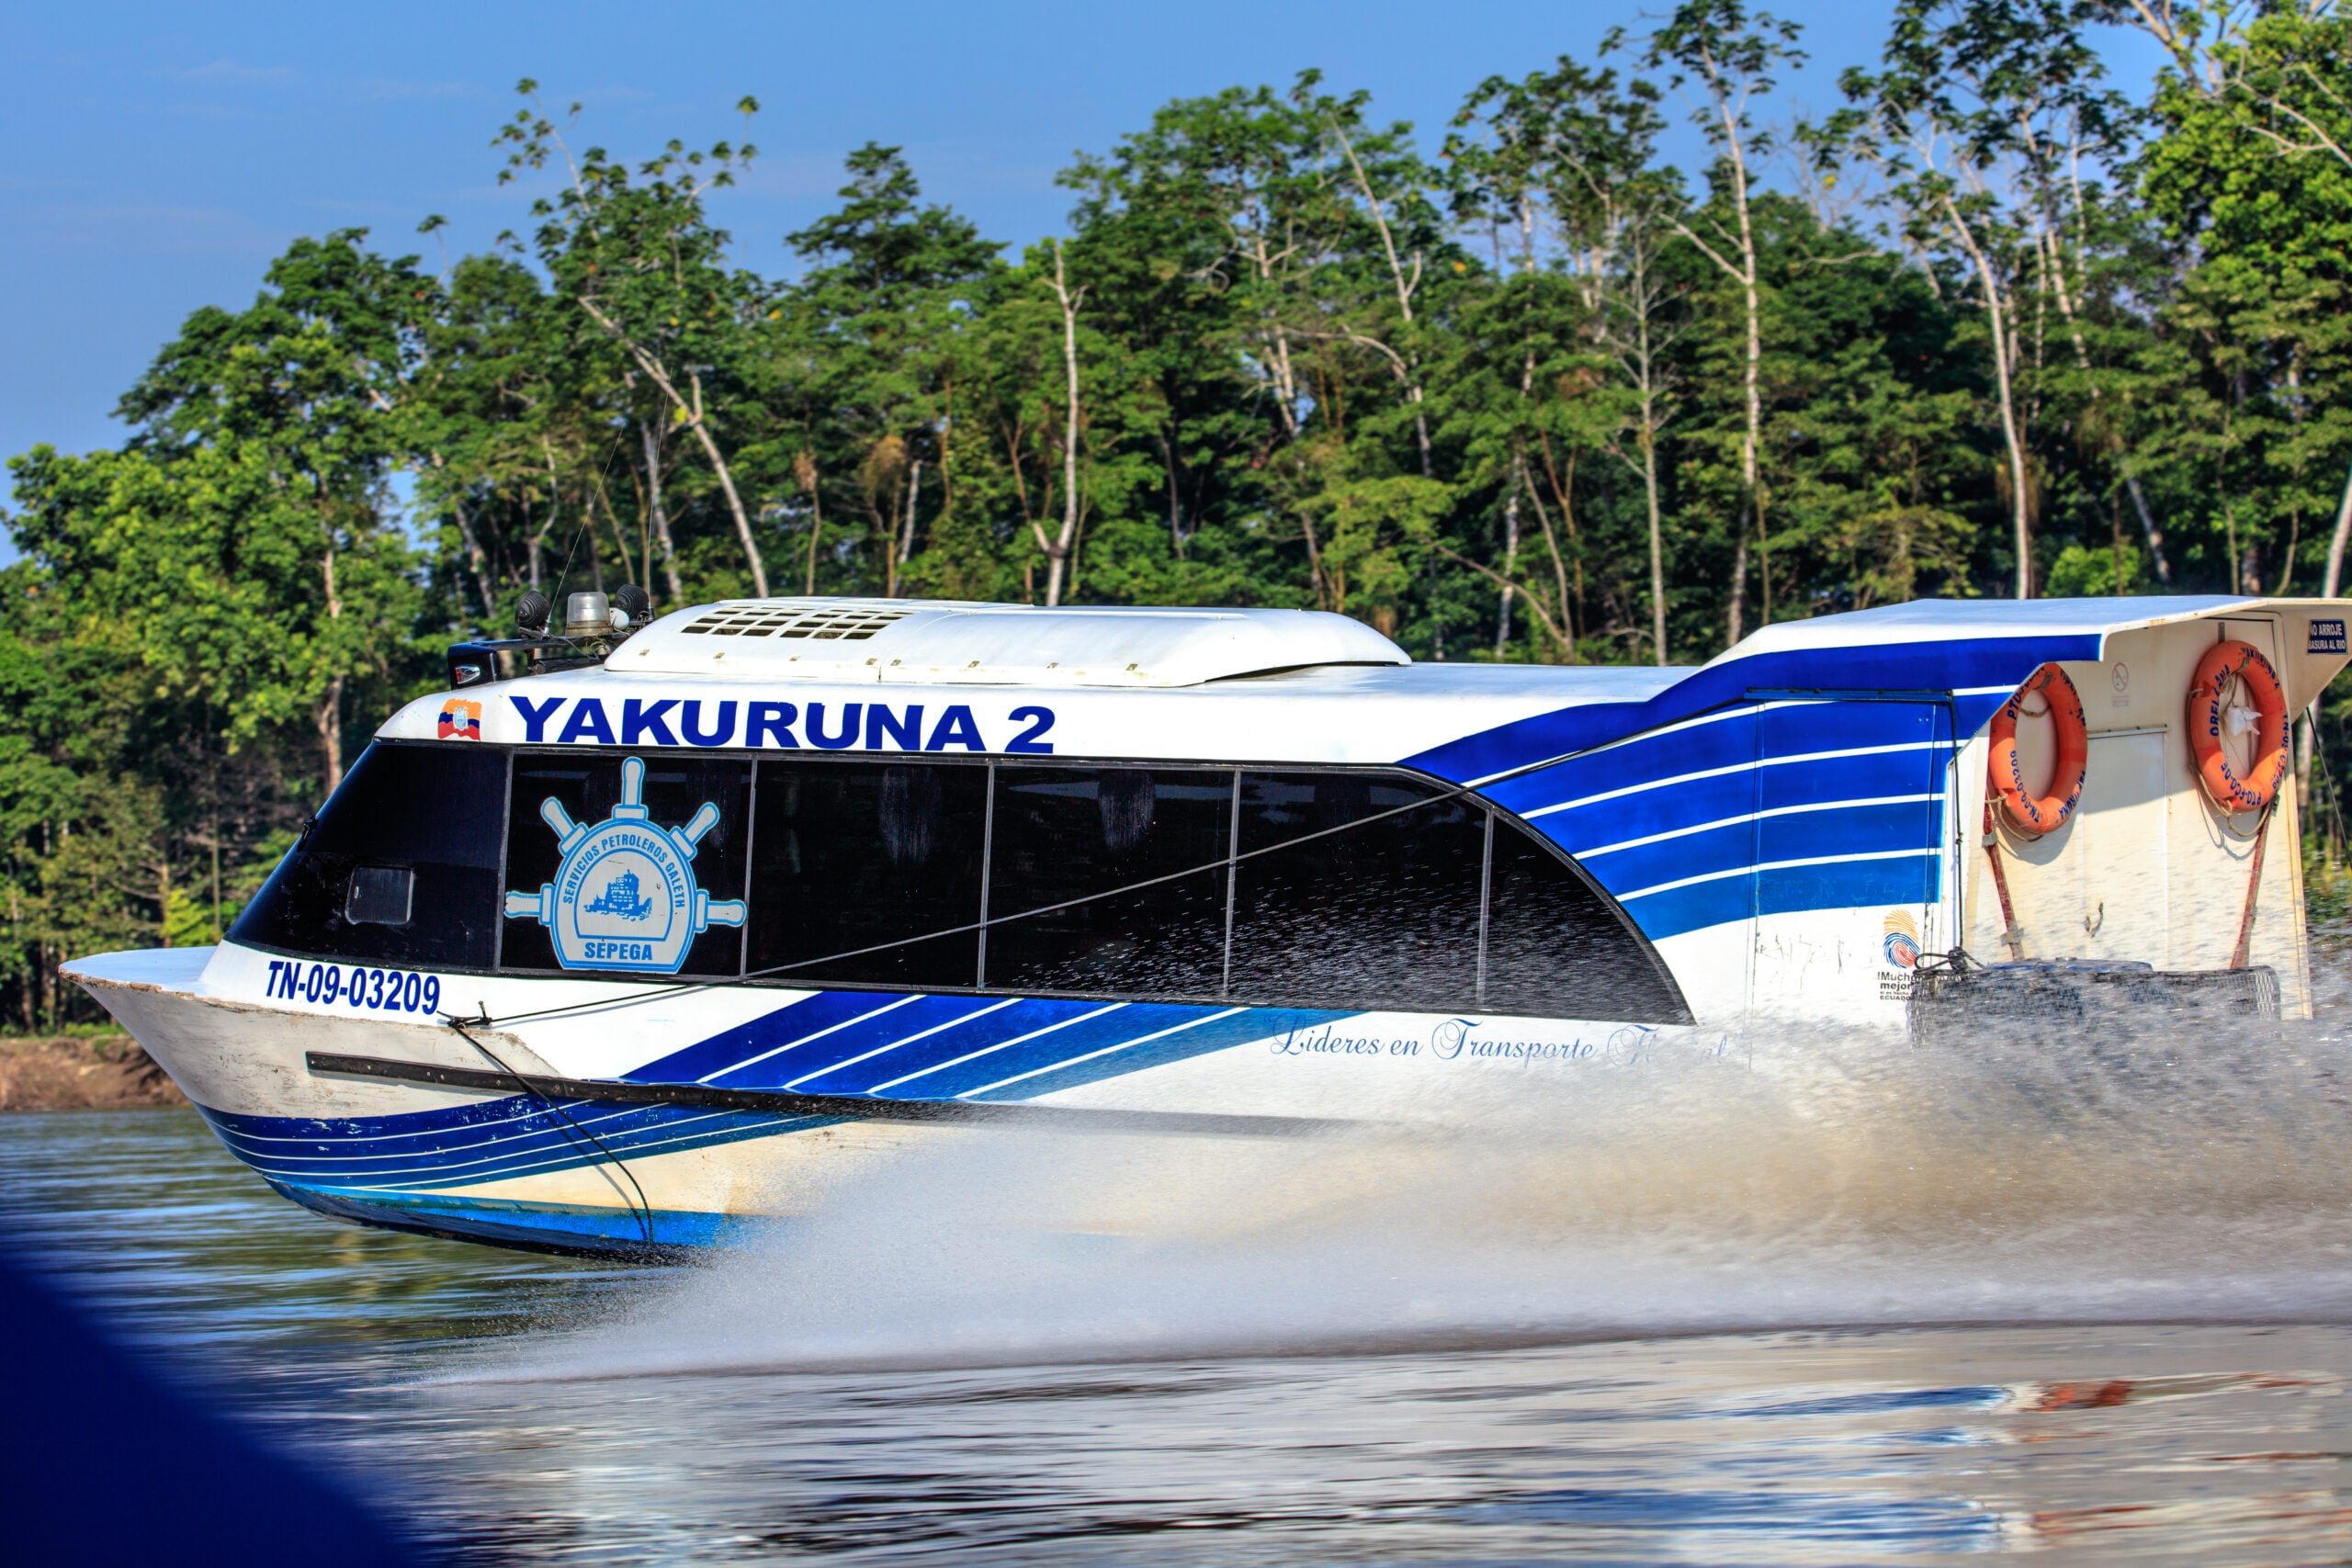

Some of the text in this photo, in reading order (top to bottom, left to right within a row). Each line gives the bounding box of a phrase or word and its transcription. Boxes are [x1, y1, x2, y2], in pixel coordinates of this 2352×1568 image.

[2319, 624, 2343, 636] ARROJE
[2329, 639, 2336, 649] AL
[509, 695, 1056, 753] YAKURUNA 2
[2210, 664, 2230, 737] ORELLANA
[562, 833, 685, 908] SERVICIOS PETROLEROS GALETH
[584, 942, 653, 961] SEPEGA
[266, 960, 441, 1015] TN-09-03209
[1390, 1038, 1424, 1056] en
[1431, 1018, 1600, 1069] Transporte
